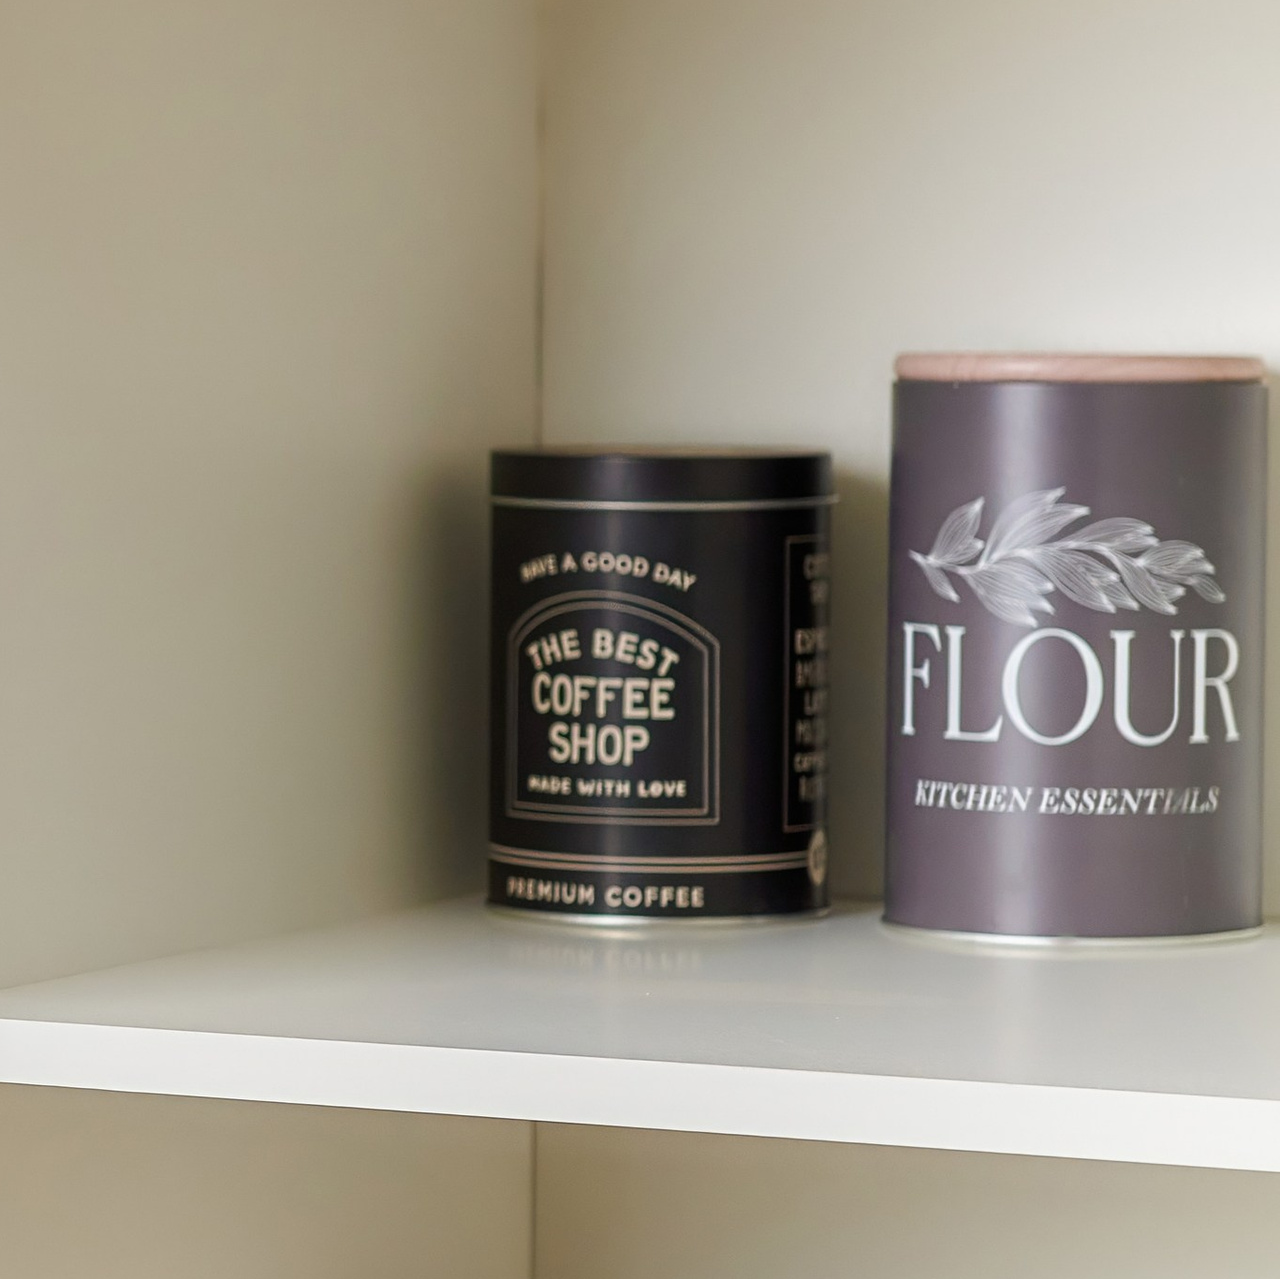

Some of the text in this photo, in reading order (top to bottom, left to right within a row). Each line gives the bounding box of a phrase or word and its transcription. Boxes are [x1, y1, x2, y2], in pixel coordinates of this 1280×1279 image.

[521, 551, 697, 592] HAVE A GOOD DAY
[525, 628, 680, 677] THE BEST
[531, 671, 675, 721] COFFEE
[899, 621, 1240, 747] FLOUR
[548, 722, 651, 767] SHOP
[527, 774, 687, 798] MADE WITH LOVE
[914, 779, 1220, 816] KITCHEN ESSENTIALS
[506, 875, 704, 908] PREMIUM COFFEE
